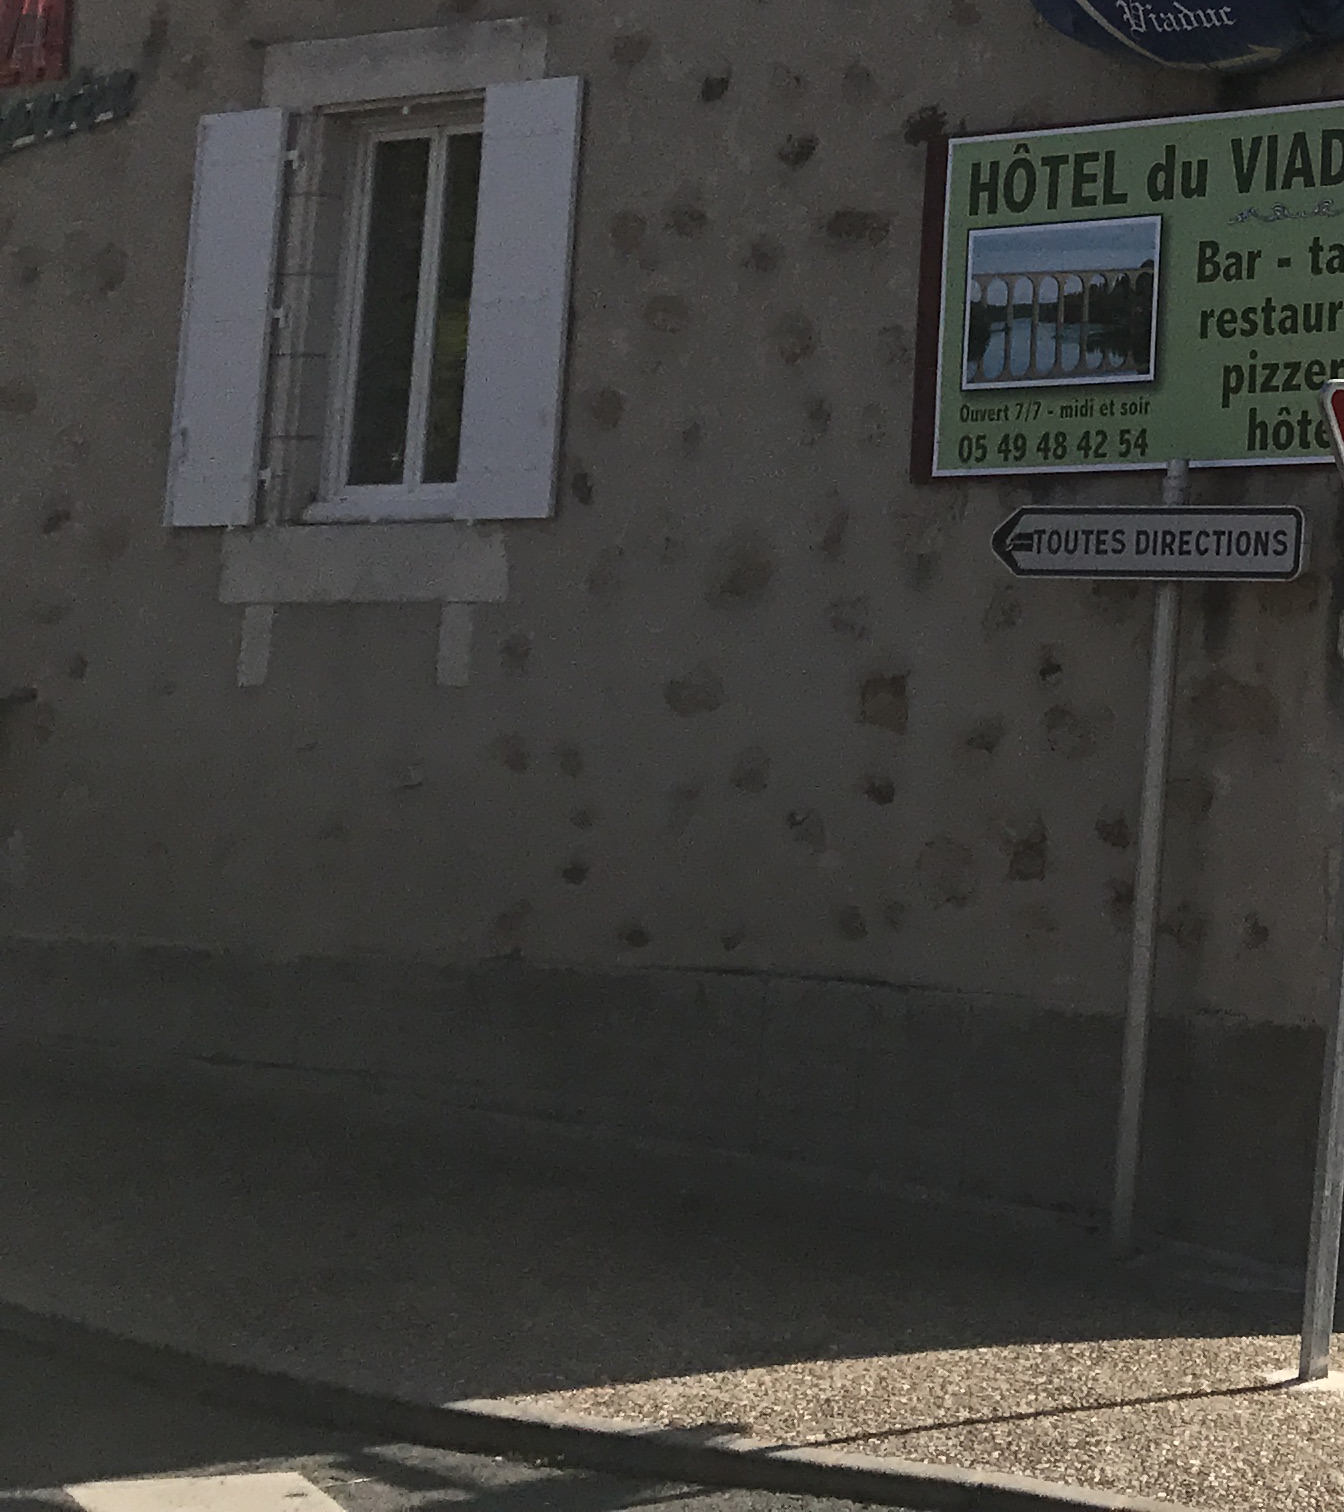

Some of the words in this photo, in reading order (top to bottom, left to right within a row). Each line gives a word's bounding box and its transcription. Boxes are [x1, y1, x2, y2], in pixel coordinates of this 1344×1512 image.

[968, 143, 1129, 217] HÔTEL
[1146, 144, 1208, 203] du
[1197, 239, 1262, 284] Bar
[959, 399, 1009, 424] Ouvert
[1014, 398, 1042, 422] 7/7
[1059, 396, 1096, 420] midi
[1099, 398, 1117, 418] et
[1121, 396, 1151, 417] soir
[1246, 406, 1332, 452] hôte
[957, 431, 988, 464] 05
[997, 431, 1026, 462] 49
[1036, 430, 1068, 461] 48
[1076, 428, 1108, 459] 42
[1118, 426, 1149, 458] 54
[1034, 529, 1127, 557] TOUTES
[1135, 529, 1289, 557] DIRECTIONS
